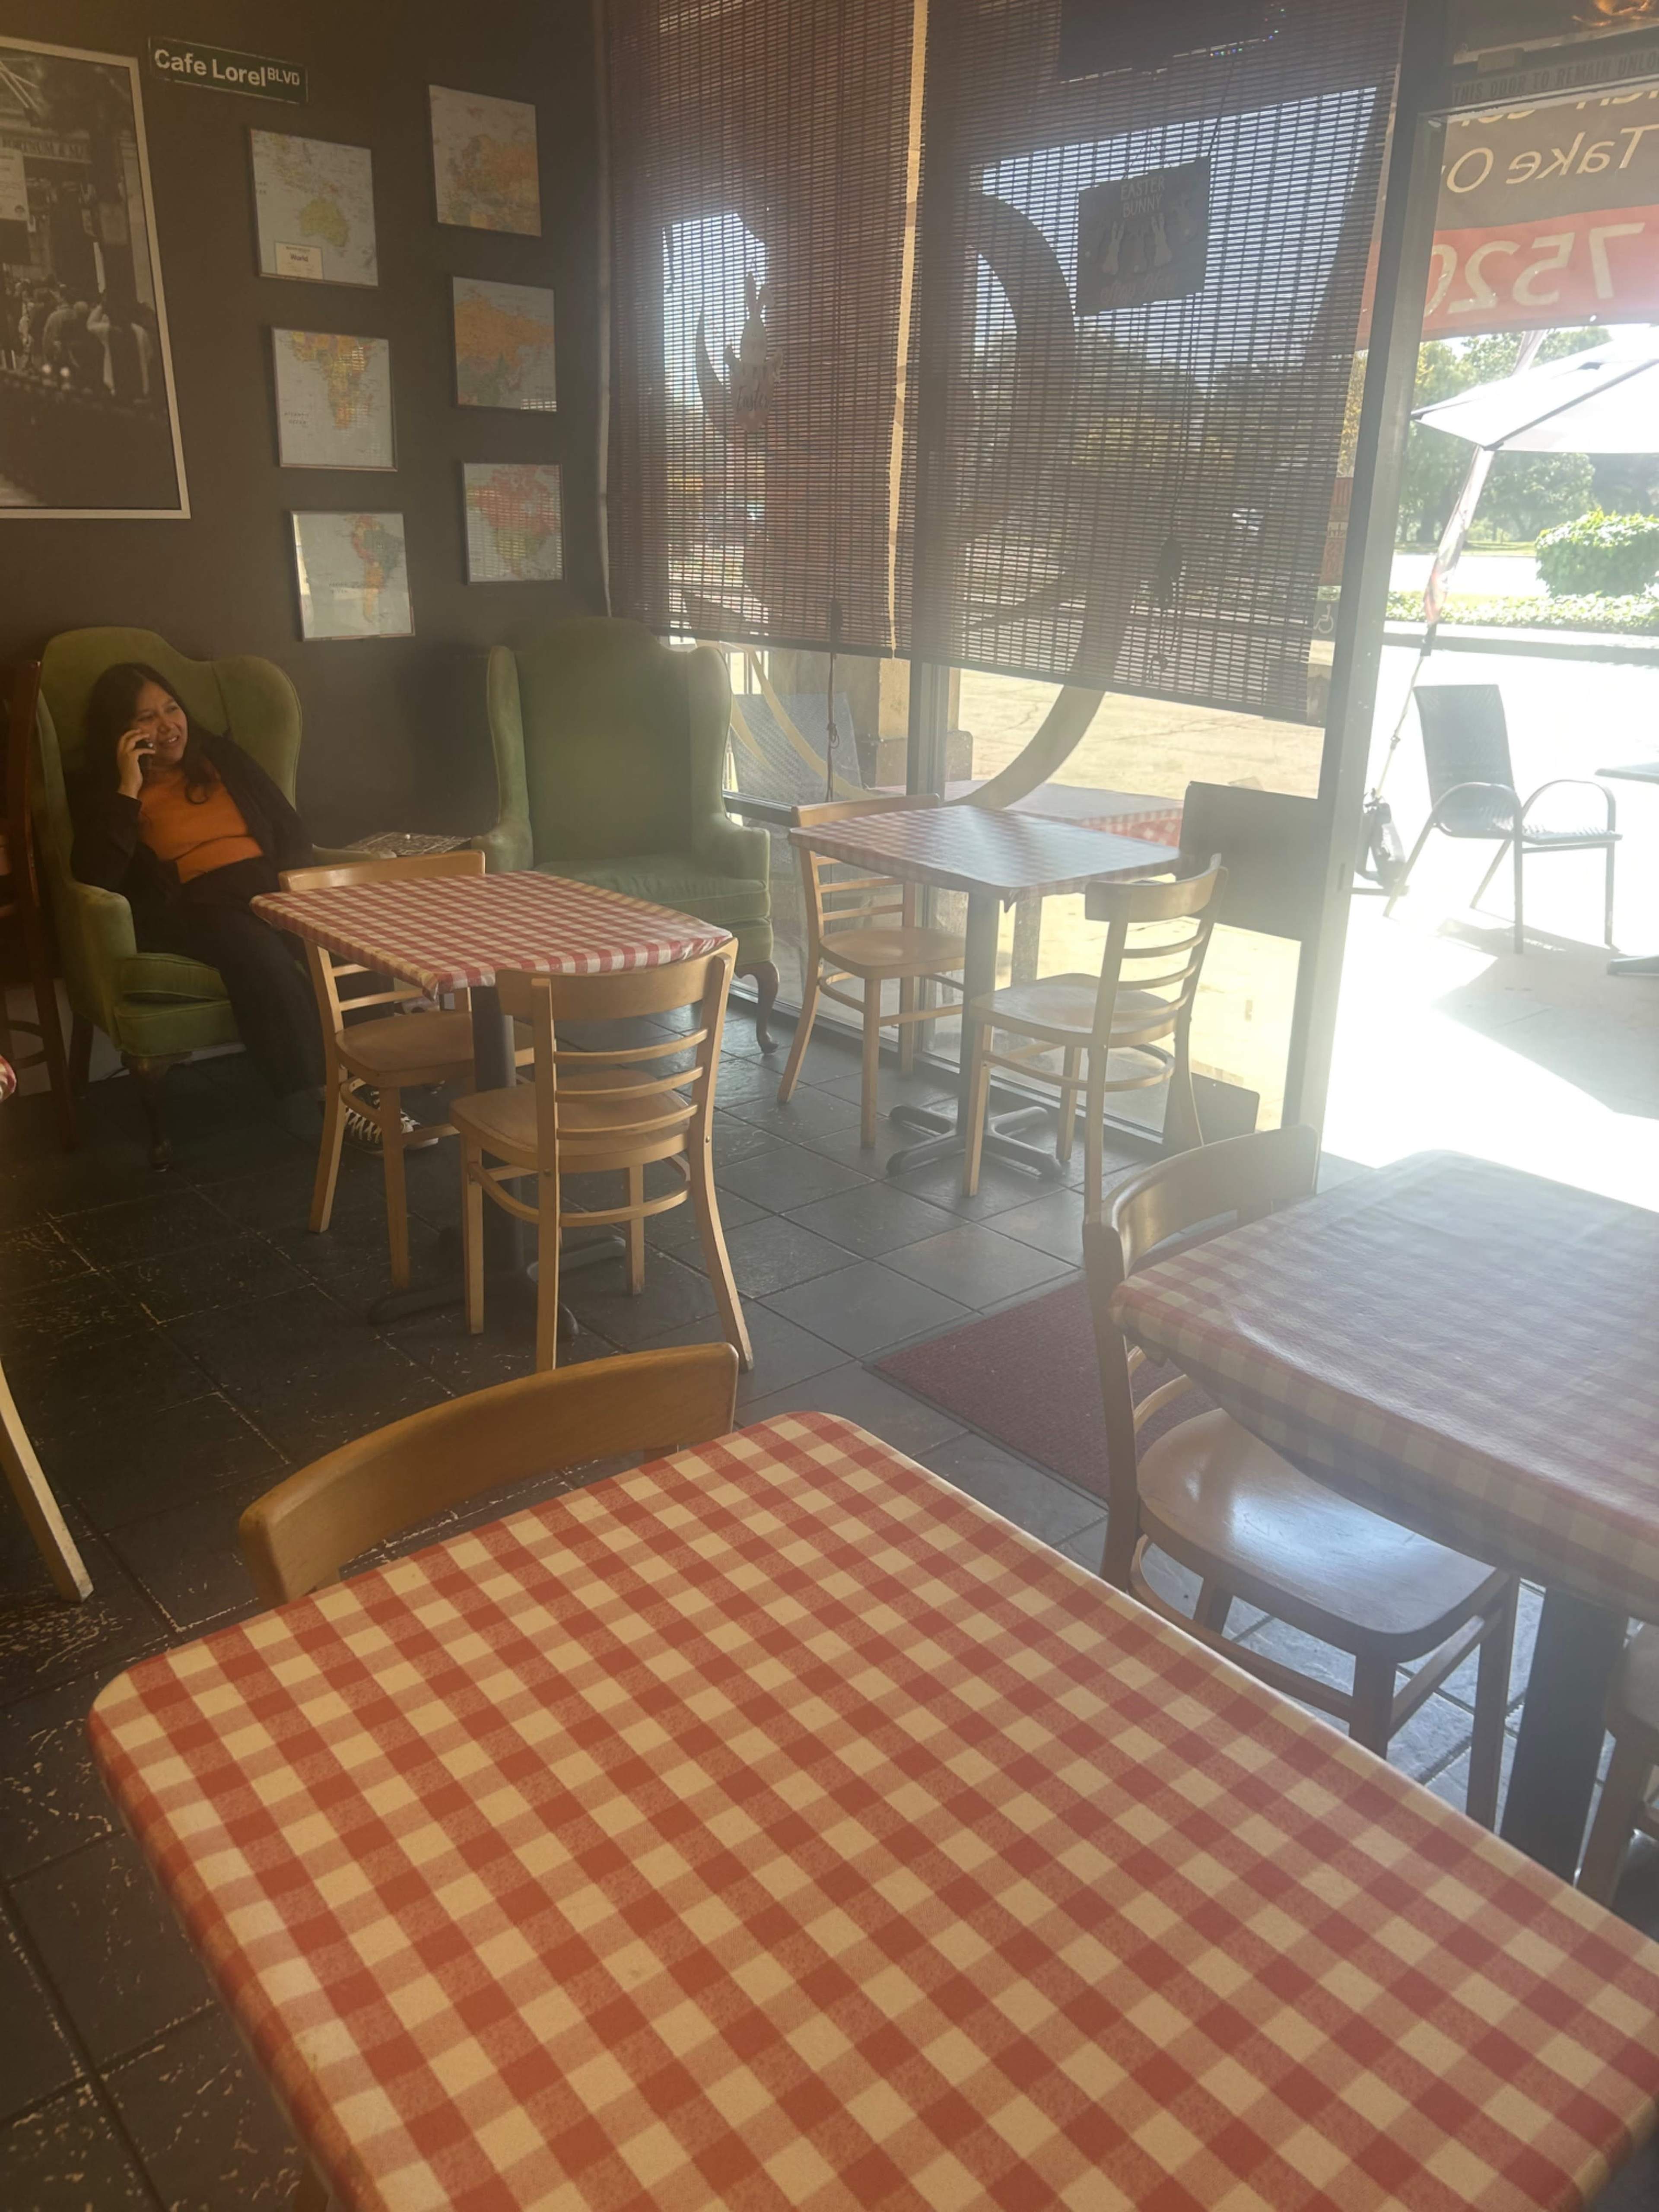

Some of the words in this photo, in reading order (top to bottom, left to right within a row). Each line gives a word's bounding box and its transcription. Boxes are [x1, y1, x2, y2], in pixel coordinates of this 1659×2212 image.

[155, 48, 207, 76] Cafe
[212, 58, 266, 87] Lorel
[267, 67, 300, 86] BLVD
[1453, 81, 1483, 104] THIS
[1490, 74, 1526, 97] DOOR
[1533, 71, 1550, 88] TO
[1555, 58, 1611, 87] REMAIN
[1618, 49, 1659, 76] UNLO
[1121, 176, 1165, 200] EASTER
[1123, 194, 1162, 218] BUNNY
